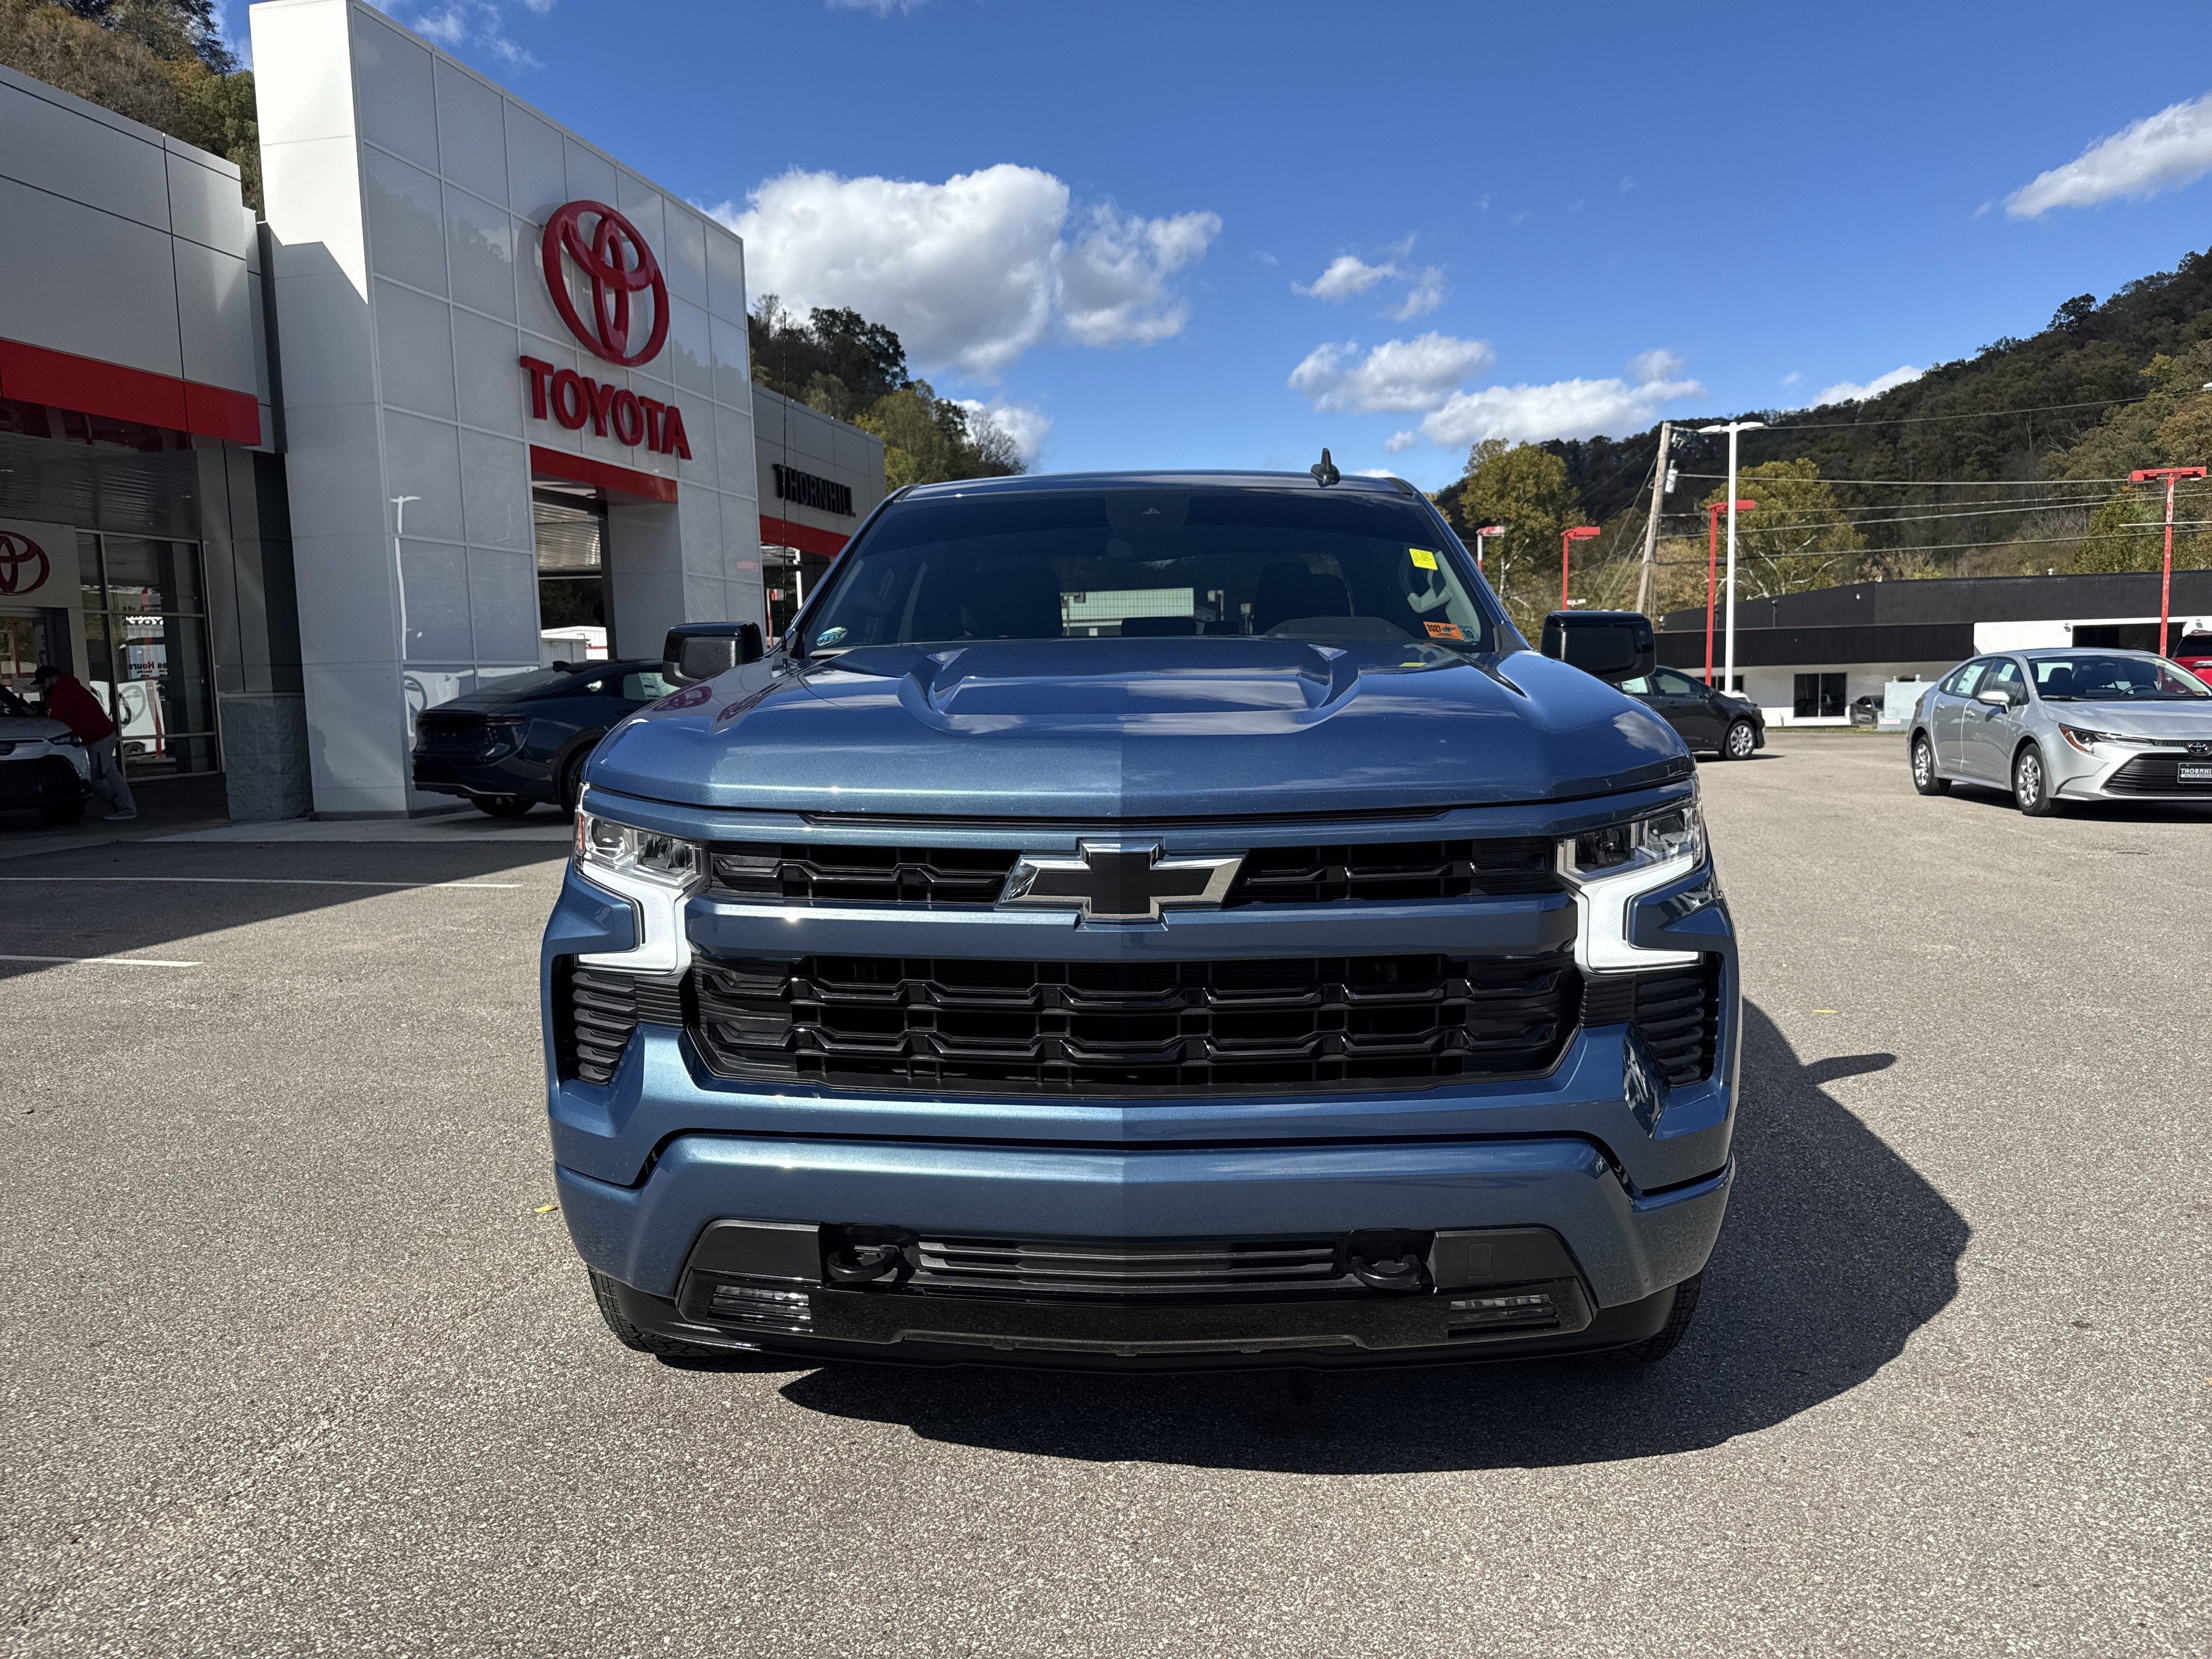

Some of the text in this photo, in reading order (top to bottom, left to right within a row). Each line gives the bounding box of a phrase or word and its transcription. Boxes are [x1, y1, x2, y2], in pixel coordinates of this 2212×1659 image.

[520, 356, 692, 461] TOYOTA
[772, 463, 856, 518] THORNHILL
[1427, 624, 1441, 633] 2027
[1463, 629, 1474, 639] 10
